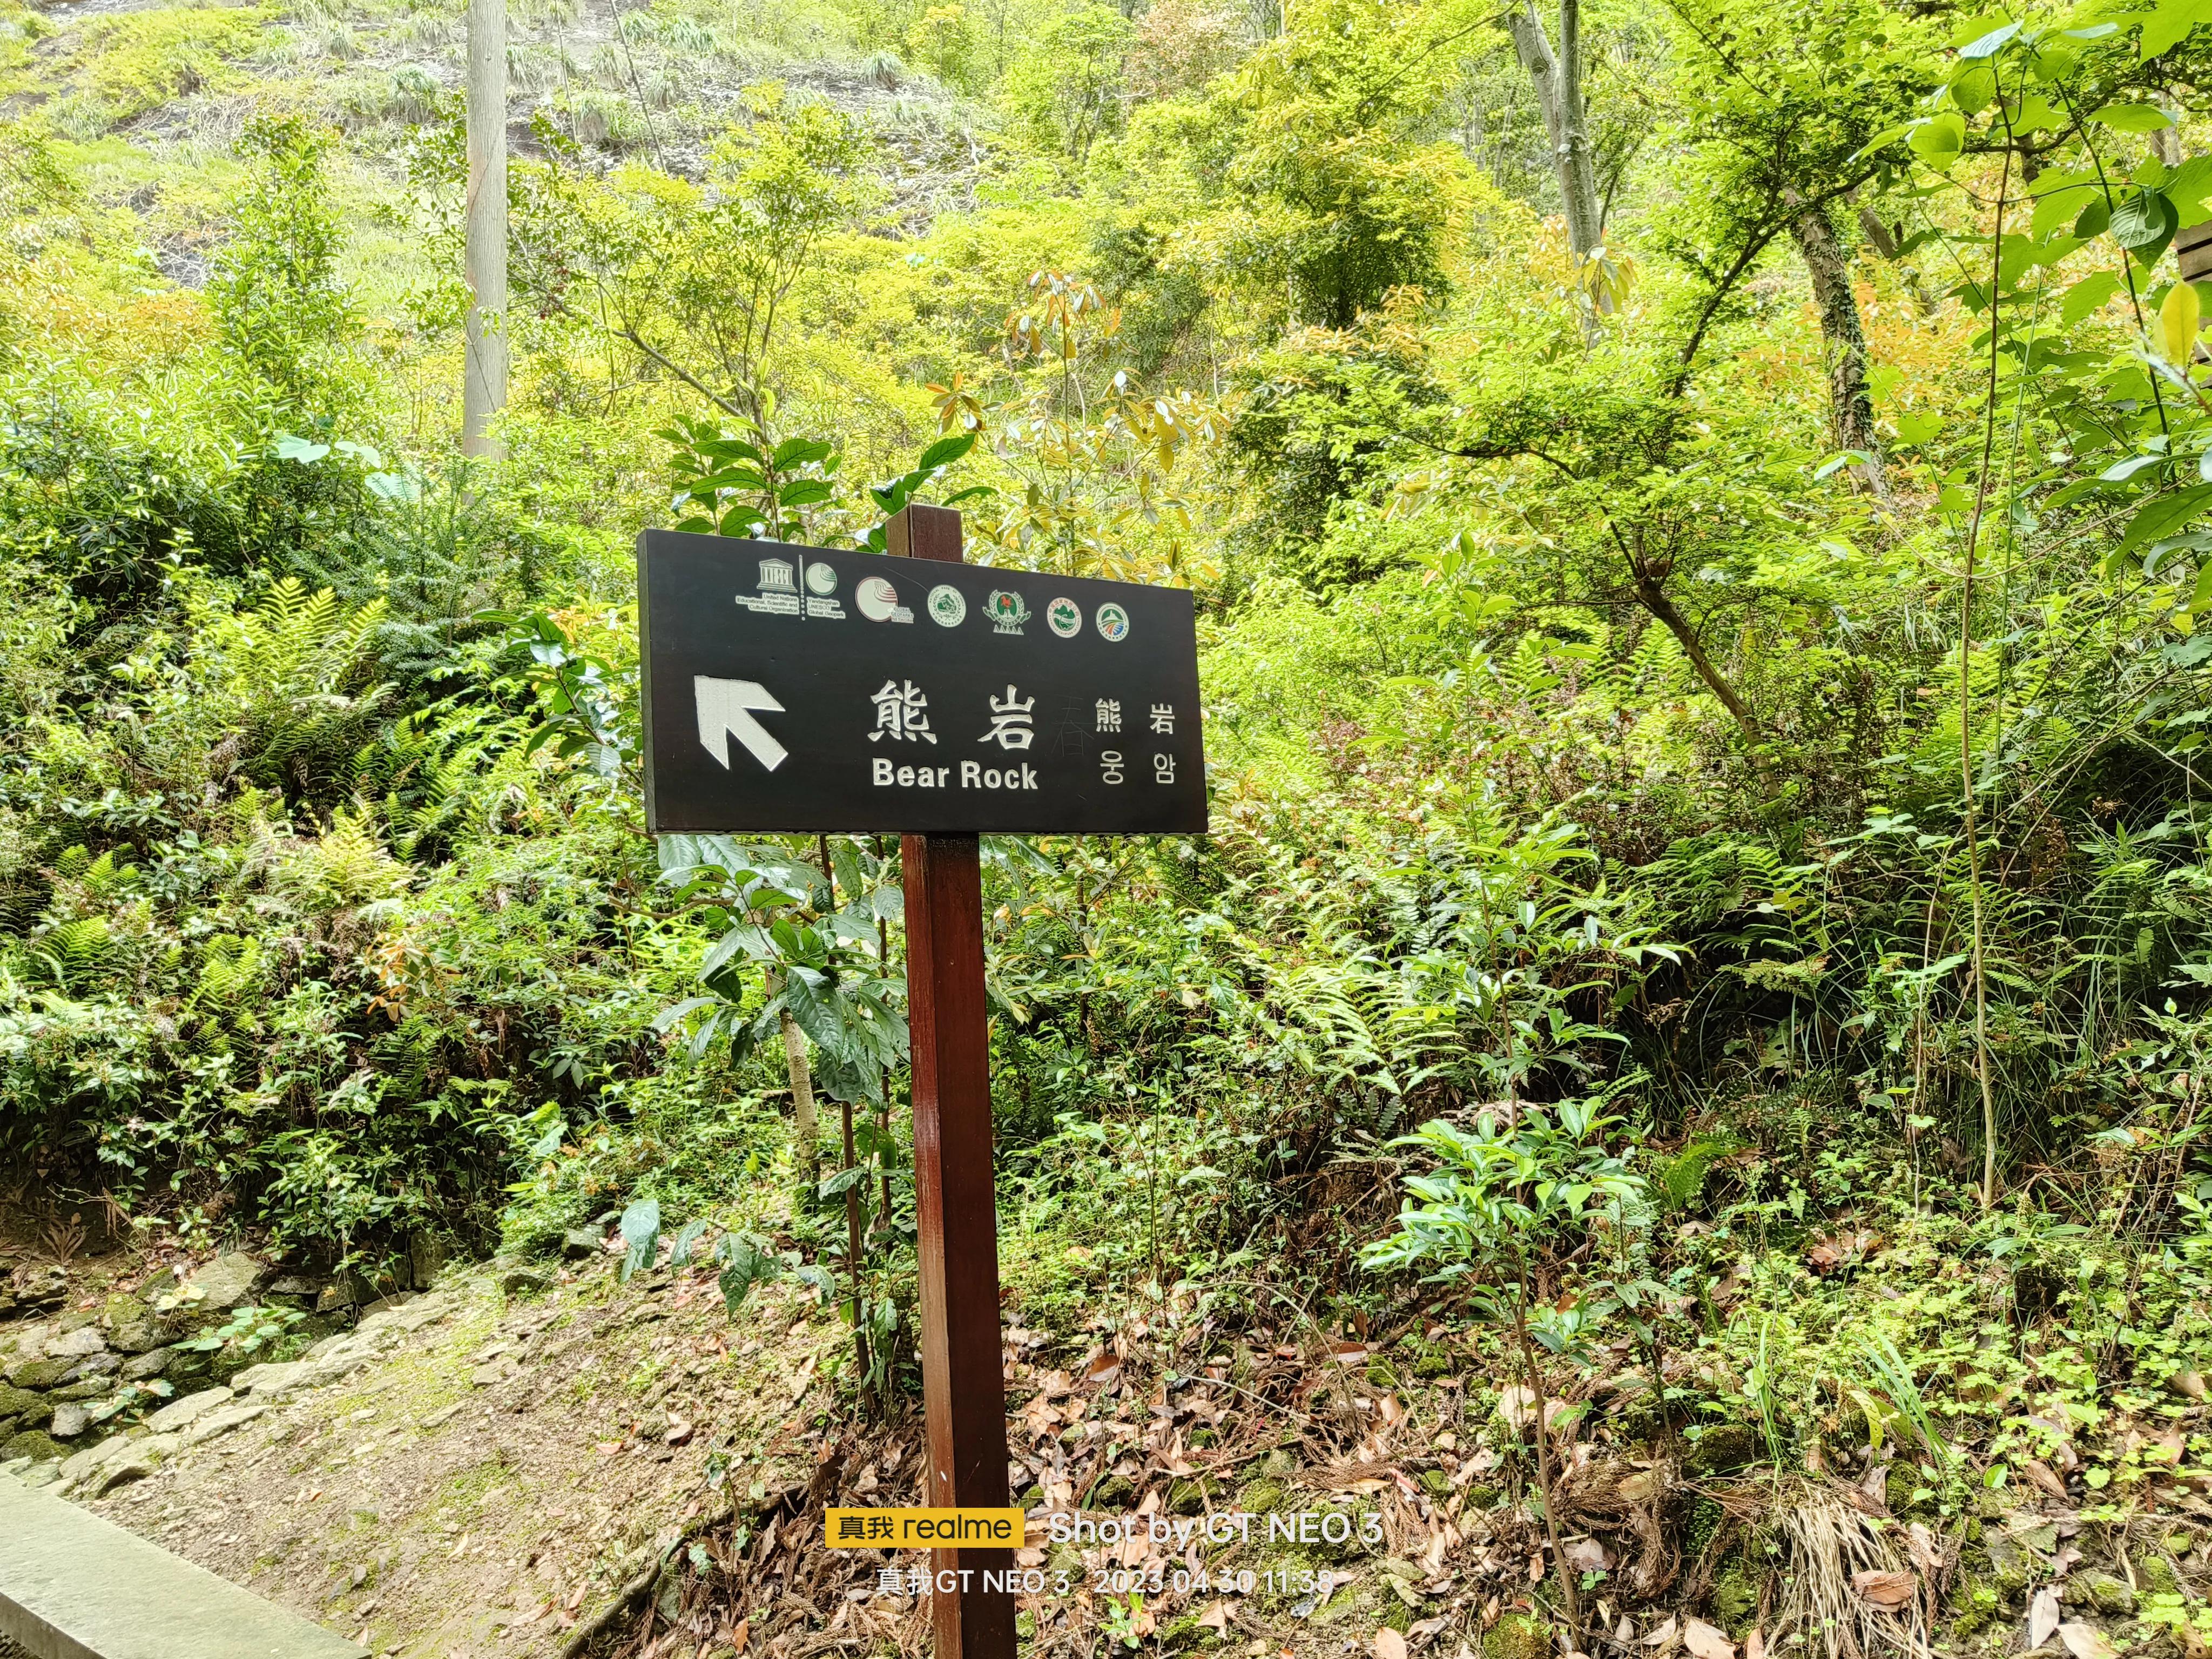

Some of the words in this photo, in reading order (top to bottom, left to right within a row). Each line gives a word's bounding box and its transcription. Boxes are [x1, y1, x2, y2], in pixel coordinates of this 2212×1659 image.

[762, 568, 791, 585] UNESCO
[872, 757, 949, 787] Bear
[960, 760, 1038, 790] Rock
